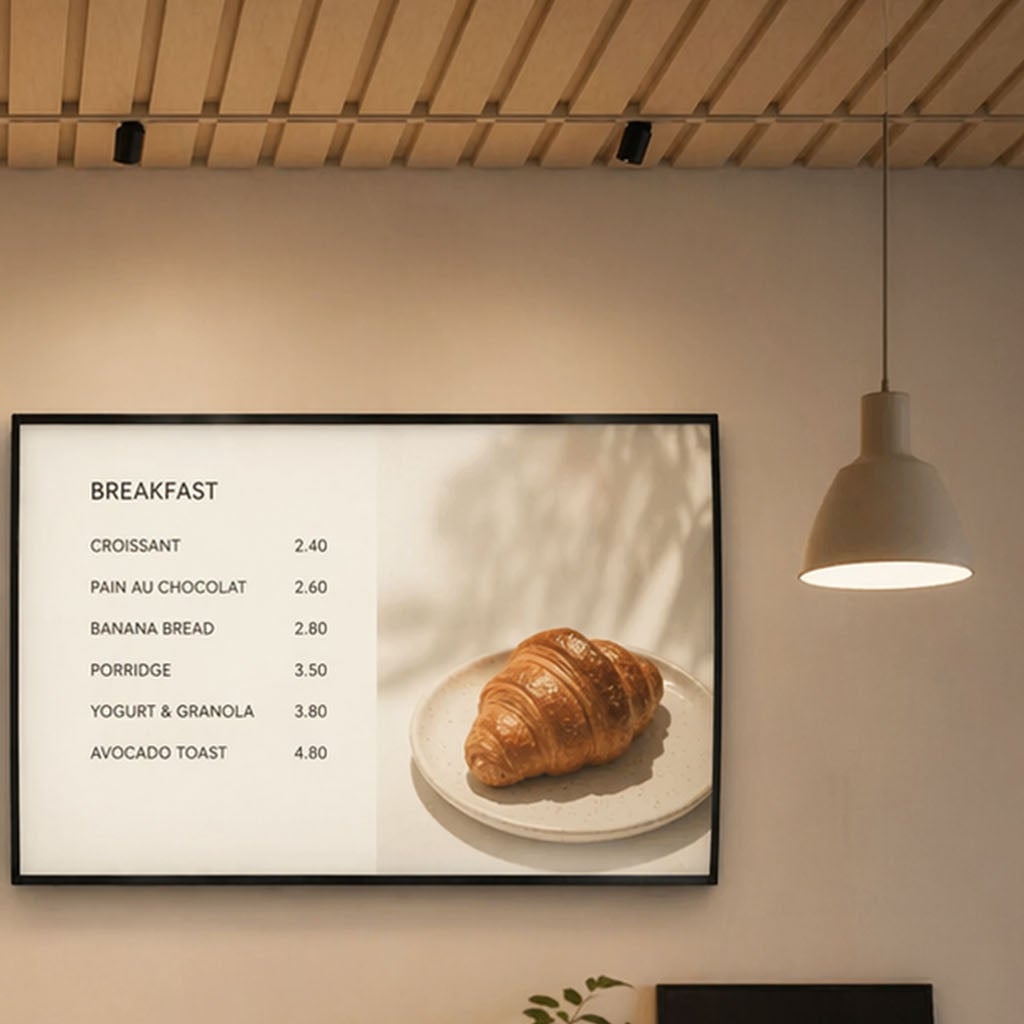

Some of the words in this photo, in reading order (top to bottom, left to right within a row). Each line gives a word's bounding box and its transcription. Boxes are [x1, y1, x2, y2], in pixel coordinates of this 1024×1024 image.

[90, 480, 219, 501] BREAKFAST
[89, 538, 182, 554] CROISSANT
[294, 538, 328, 553] 2.40
[90, 579, 127, 594] PAIN
[130, 580, 154, 595] AU
[157, 579, 247, 595] CHOCOLAT
[294, 579, 328, 595] 2.60
[90, 620, 159, 636] BANANA
[162, 620, 215, 636] BREAD
[294, 620, 328, 636] 2.80
[90, 662, 172, 678] PORRIDGE
[294, 662, 328, 678] 3.50
[90, 703, 157, 719] YOGURT
[160, 704, 172, 719] &
[175, 703, 255, 719] GRANOLA
[294, 703, 328, 719] 3.80
[89, 745, 172, 761] AVOCADO
[175, 745, 228, 760] TOAST
[293, 745, 328, 760] 4.80
